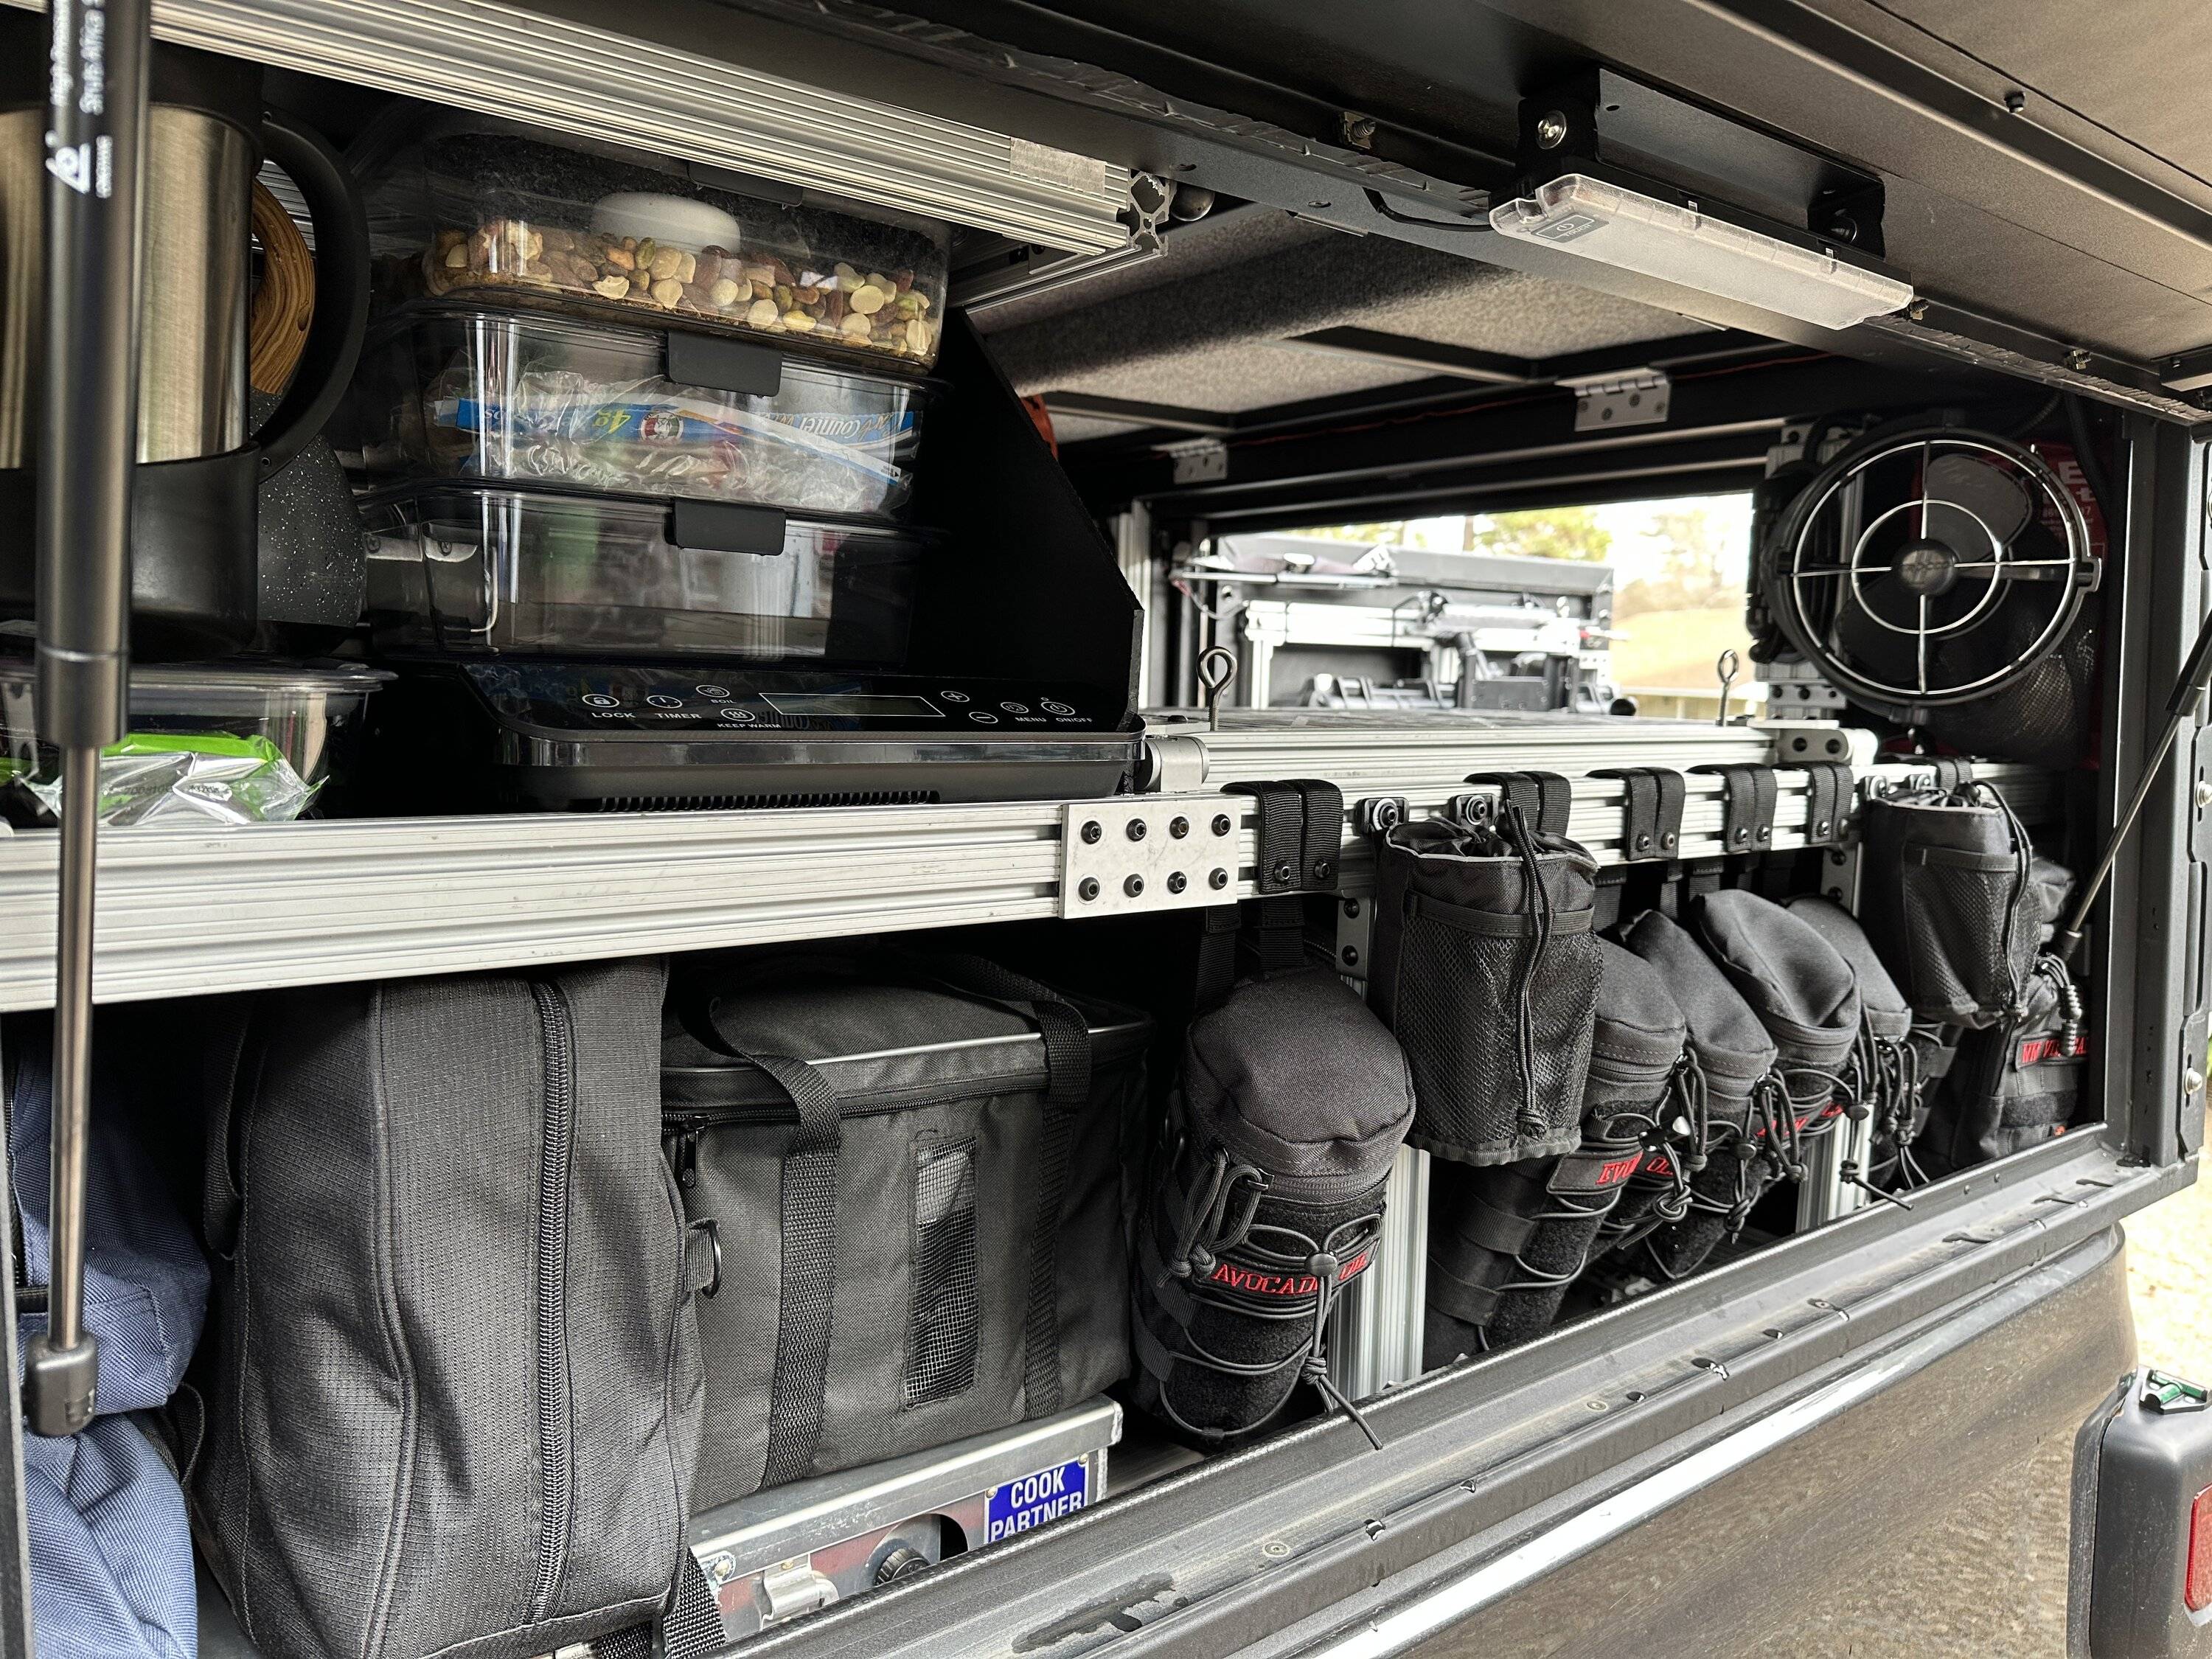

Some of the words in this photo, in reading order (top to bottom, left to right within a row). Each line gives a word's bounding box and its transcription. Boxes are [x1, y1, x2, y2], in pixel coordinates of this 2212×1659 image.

[1211, 1262, 1318, 1295] AVOCAD
[1338, 1251, 1369, 1281] OIL
[1010, 1466, 1066, 1509] COOK
[990, 1490, 1083, 1542] PARTNER
